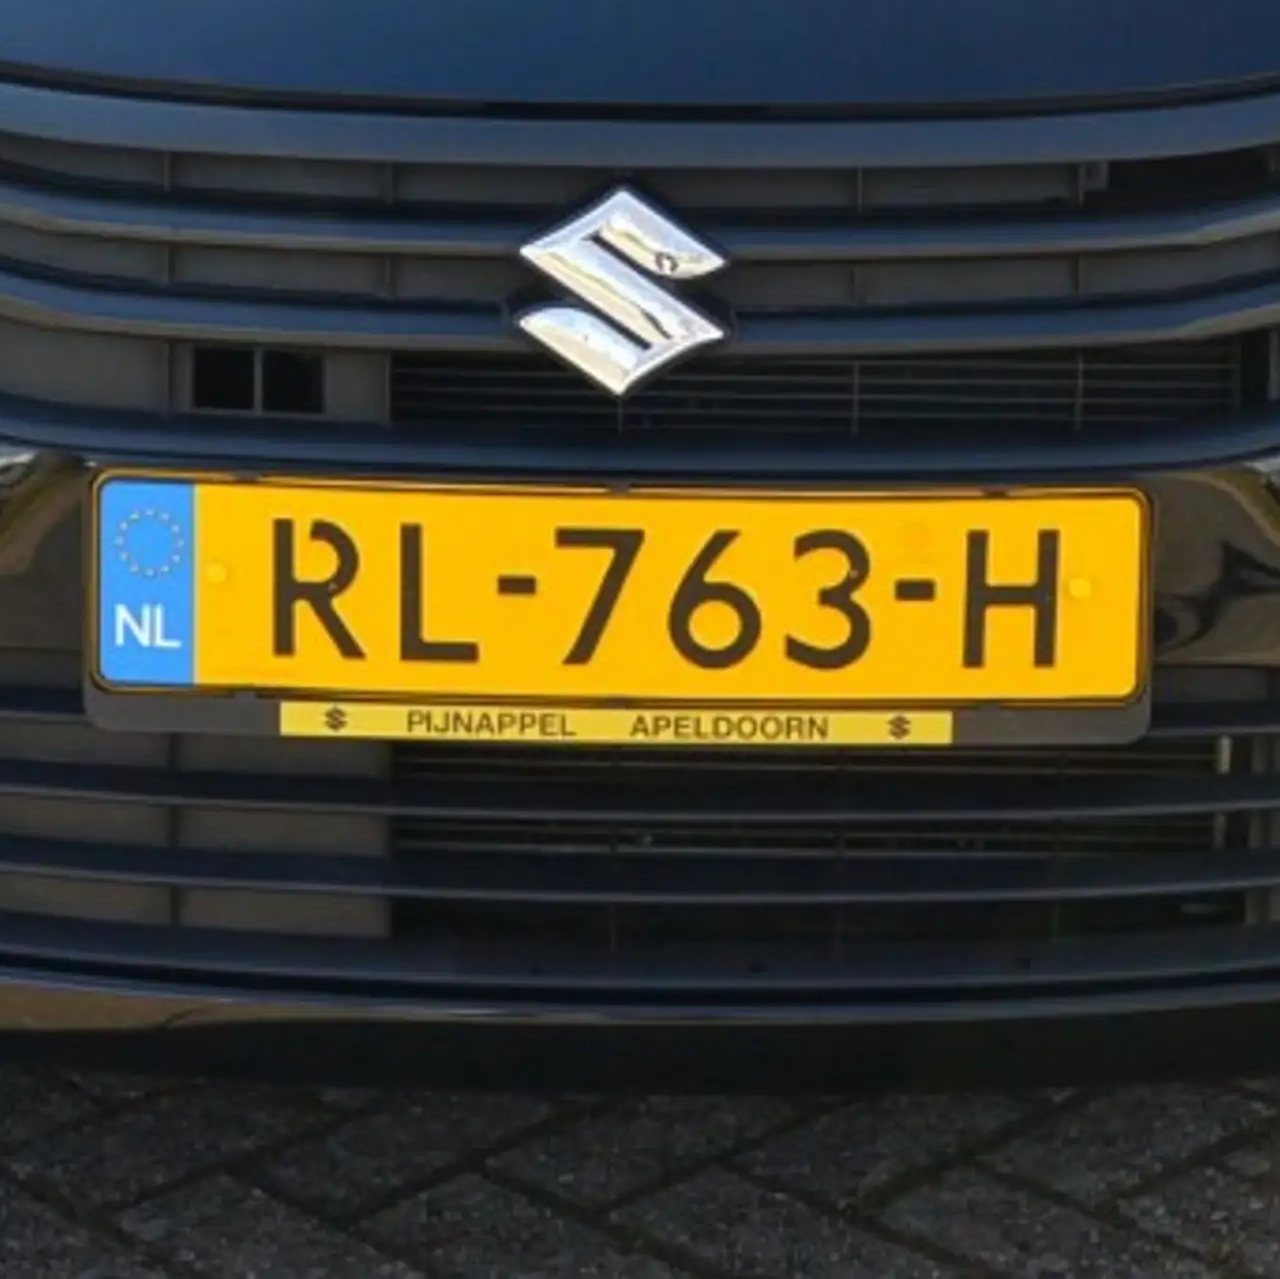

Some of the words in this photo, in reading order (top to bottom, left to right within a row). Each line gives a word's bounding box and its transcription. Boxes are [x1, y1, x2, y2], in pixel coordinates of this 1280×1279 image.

[271, 518, 1061, 670] RL-763-H
[113, 603, 183, 650] NL
[406, 710, 577, 737] PIJNAPPEL
[629, 713, 829, 741] APELDOORN
